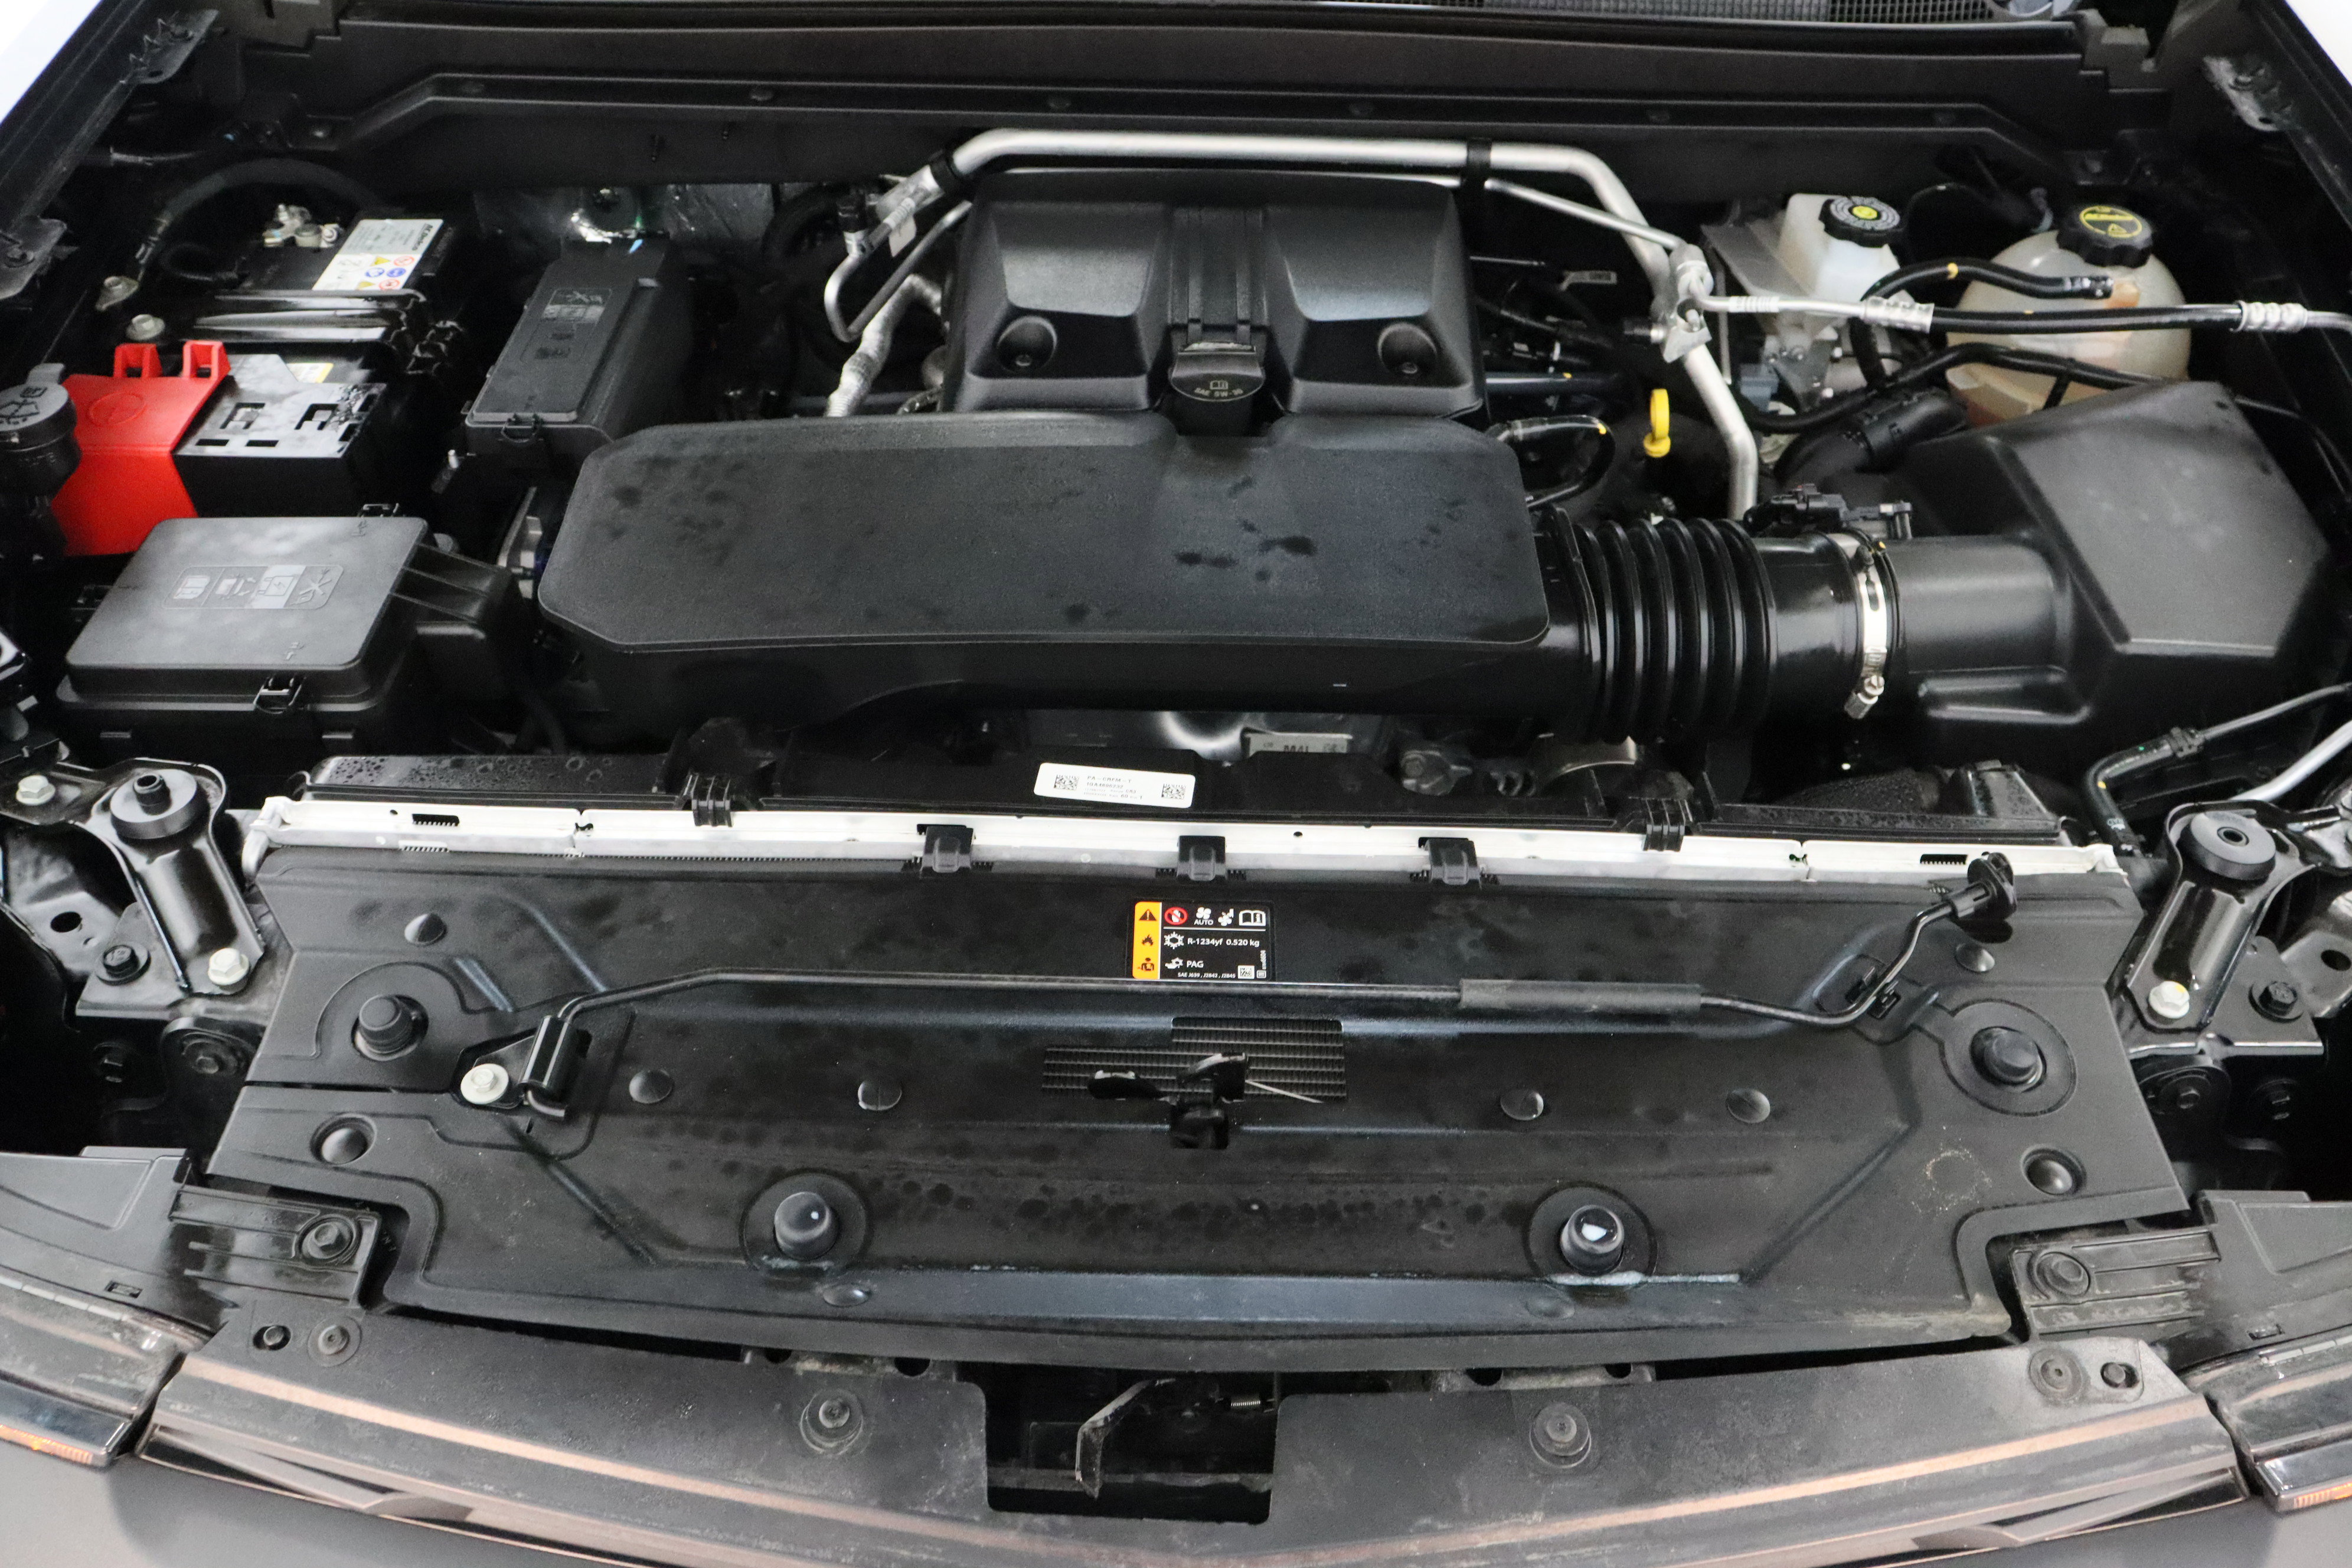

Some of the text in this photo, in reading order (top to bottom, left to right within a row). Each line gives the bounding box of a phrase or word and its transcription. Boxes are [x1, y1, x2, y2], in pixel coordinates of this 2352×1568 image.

[1187, 937, 1223, 947] R-1234yf
[1249, 939, 1260, 948] kg
[1187, 960, 1204, 968] PAG
